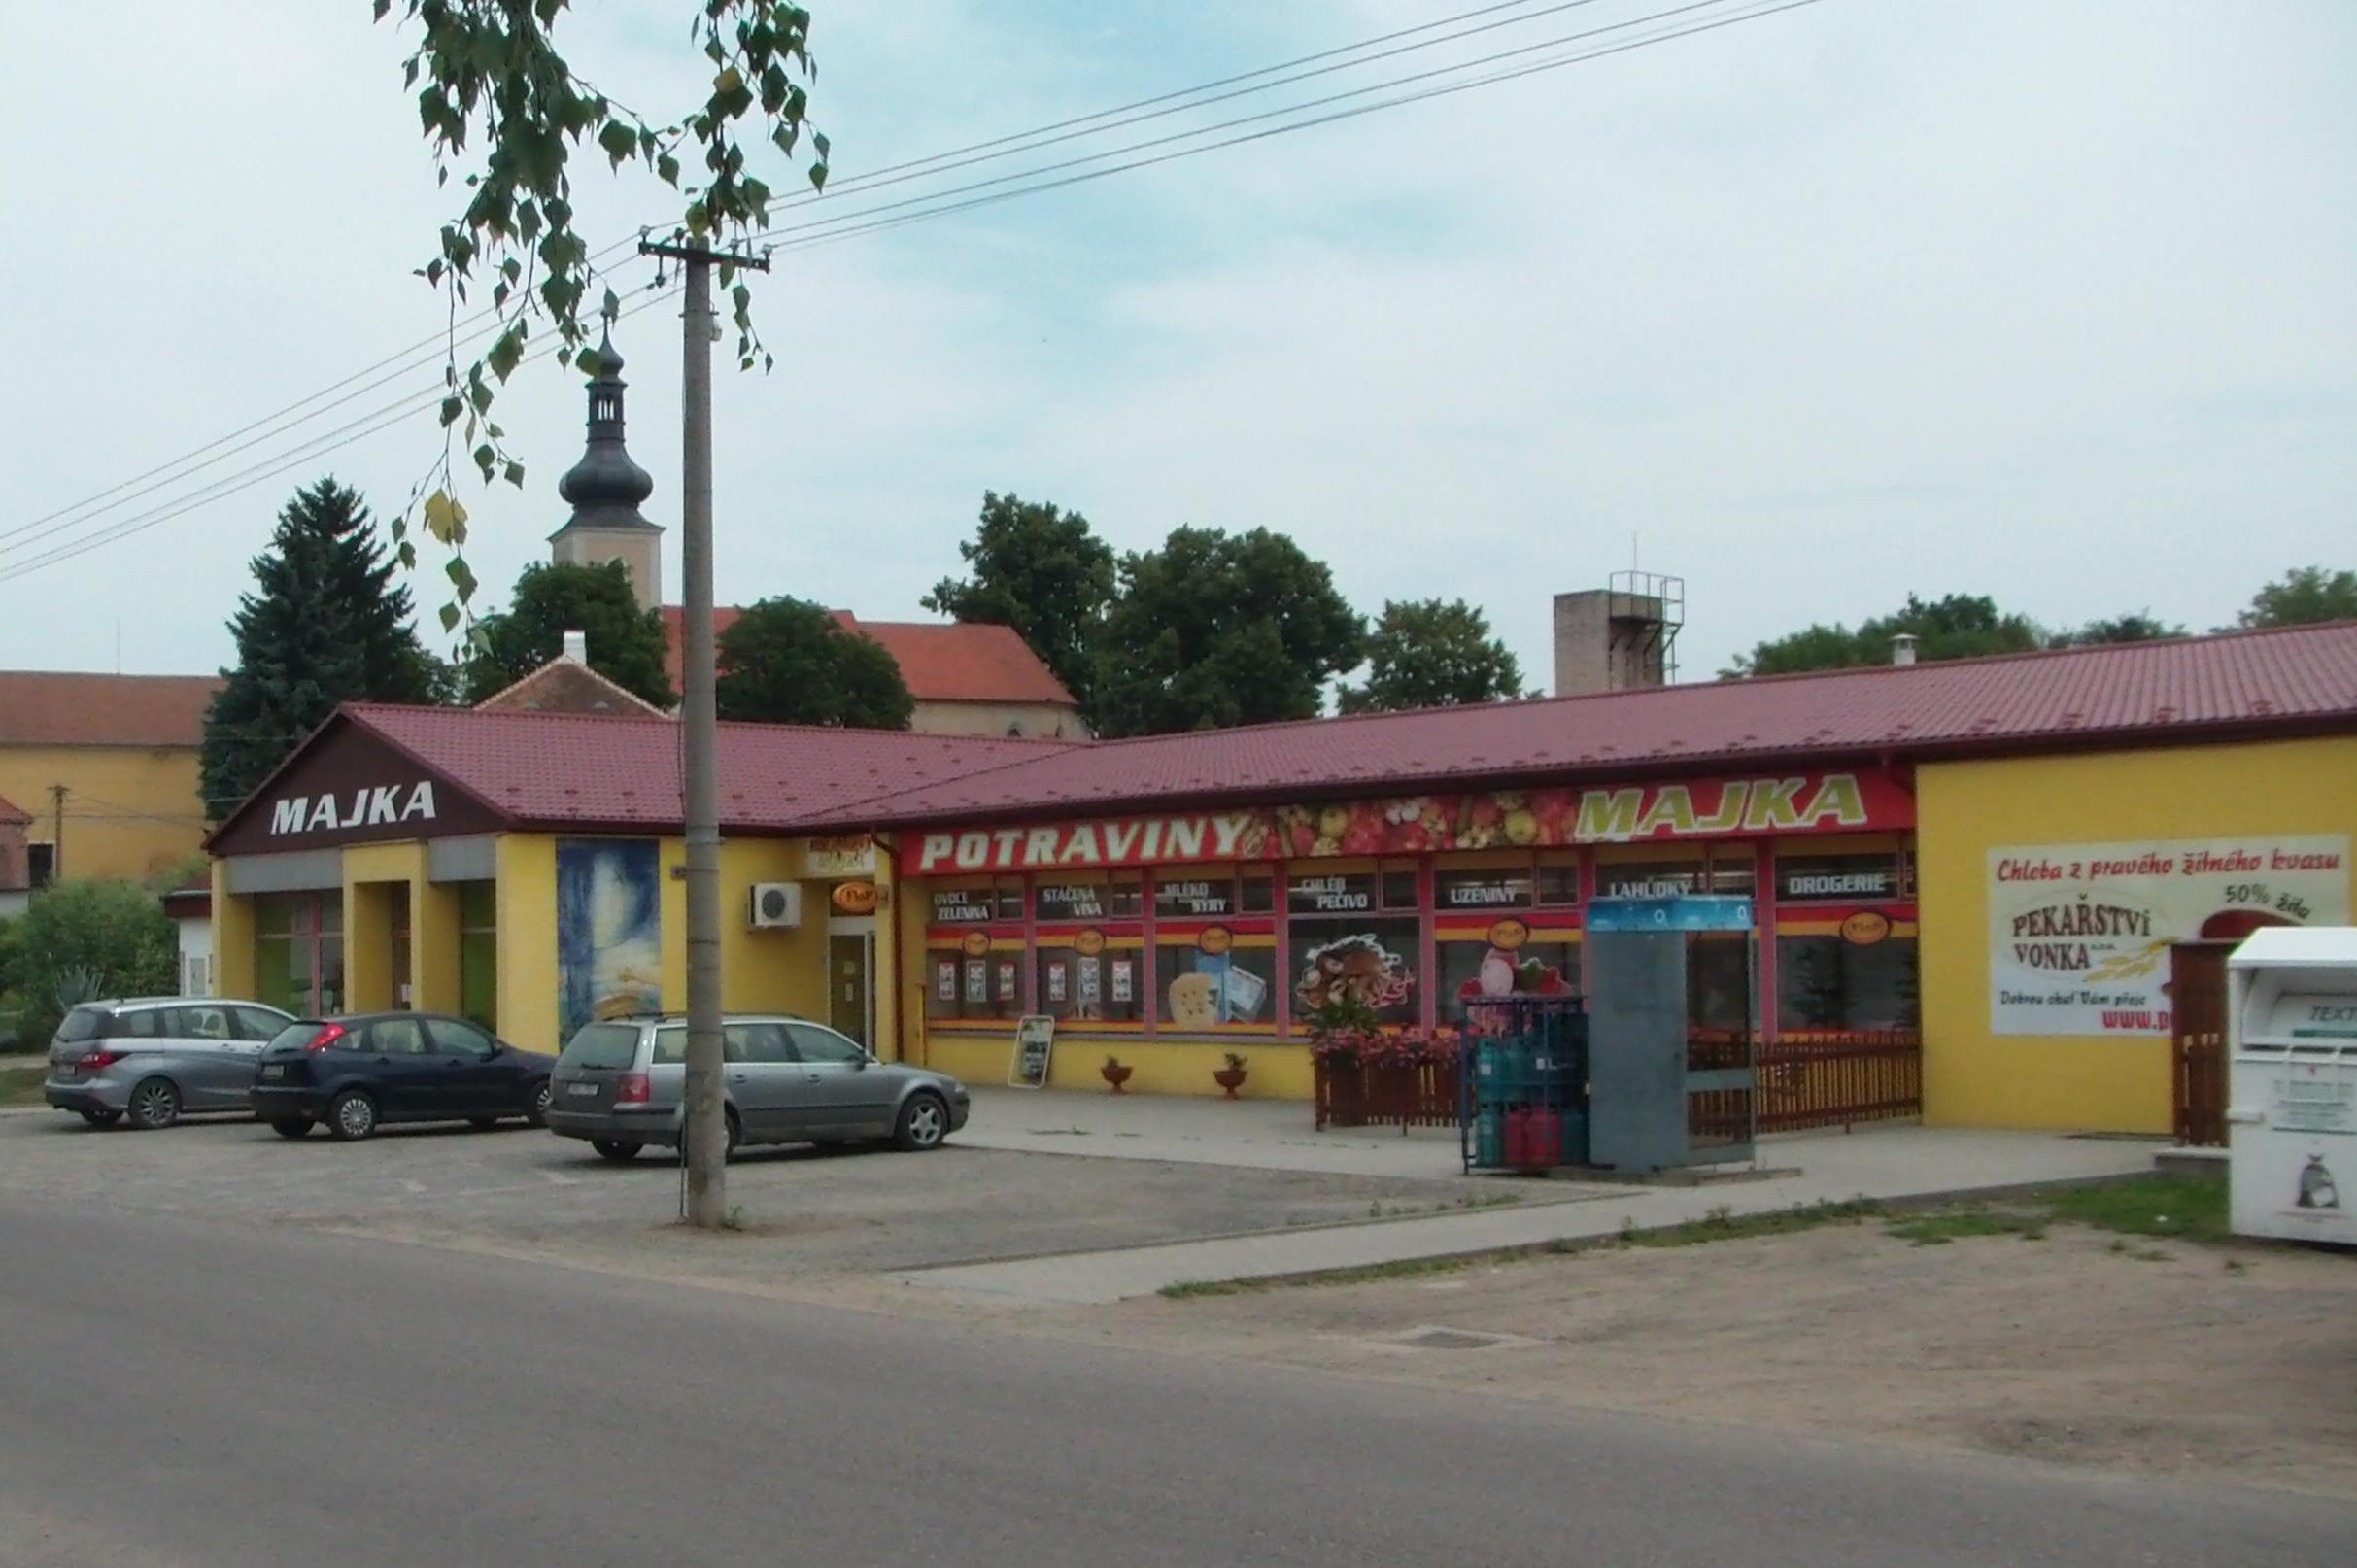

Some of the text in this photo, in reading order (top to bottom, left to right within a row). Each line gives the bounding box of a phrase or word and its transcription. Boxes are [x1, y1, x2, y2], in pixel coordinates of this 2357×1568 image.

[270, 780, 436, 835] MAJKA
[1574, 773, 1867, 843] MAJKA
[919, 814, 1248, 871] POTRAVINY
[1998, 847, 2340, 882] Chleba z pravého žitného kvasu
[1451, 887, 1519, 903] UZENINY
[1789, 873, 1886, 894] DROGERIE
[2226, 883, 2271, 904] 50%
[2012, 892, 2152, 937] PEKAŘSTVÍ
[2013, 943, 2091, 971] VONKA
